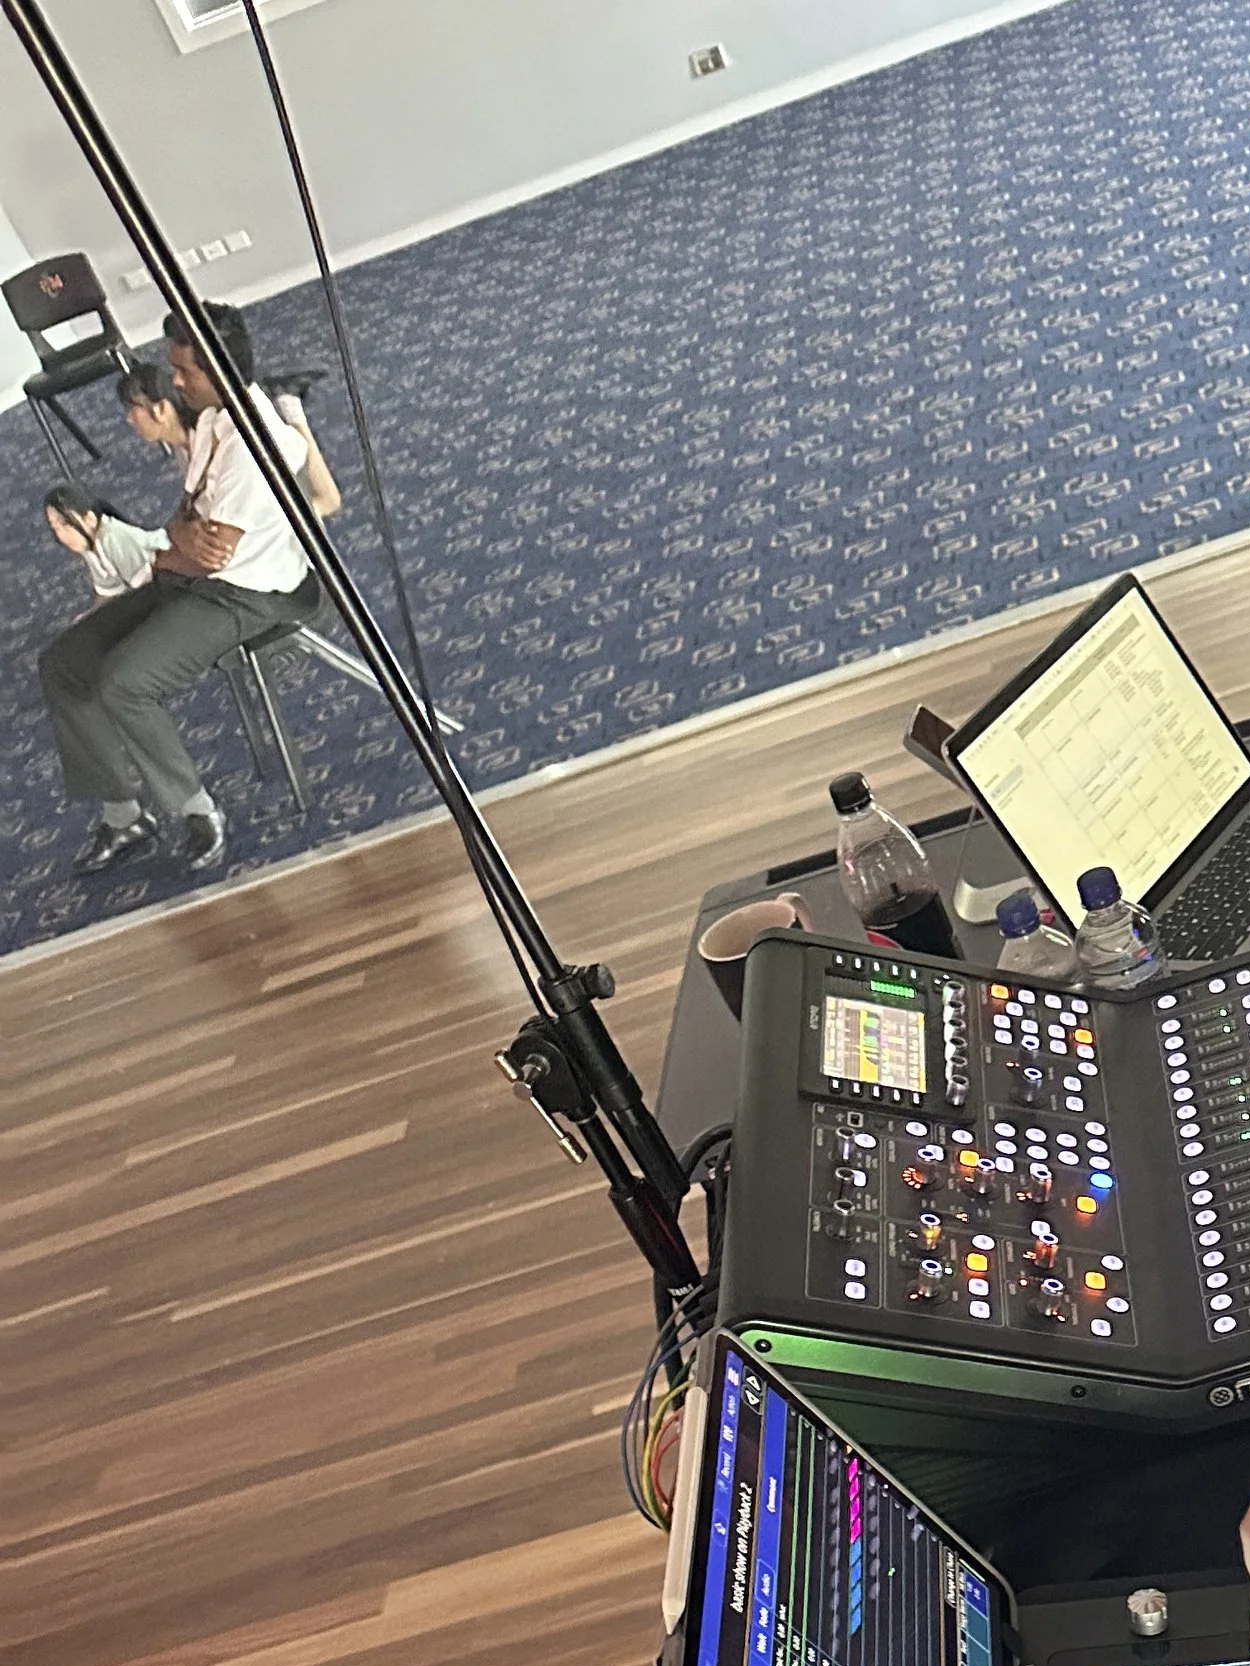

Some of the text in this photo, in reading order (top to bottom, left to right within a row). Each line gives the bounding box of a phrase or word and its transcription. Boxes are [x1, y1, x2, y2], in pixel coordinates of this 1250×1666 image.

[766, 1473, 777, 1515] Comment
[729, 1479, 754, 1615] basic show on Playback 2
